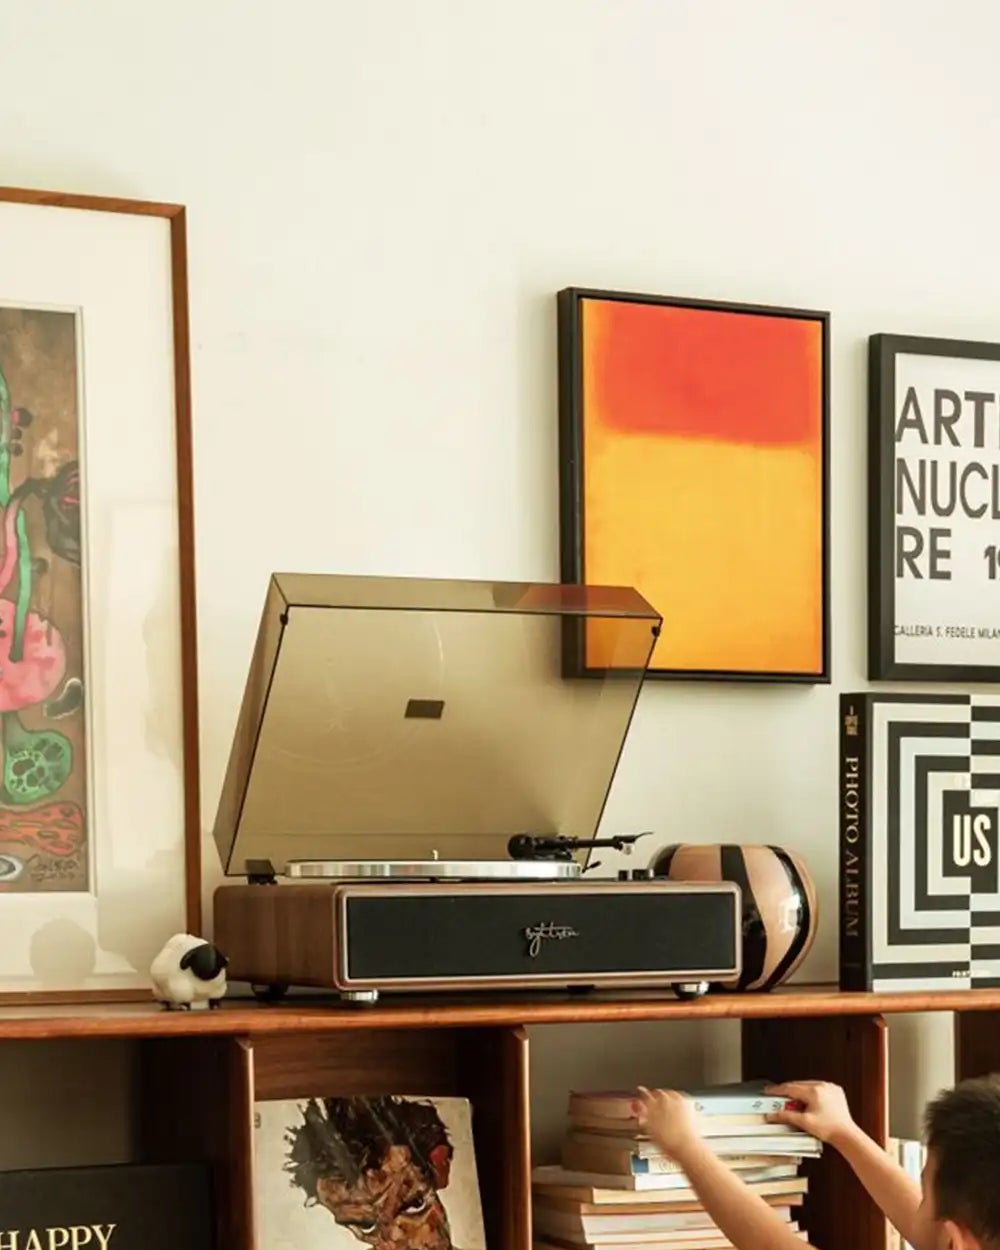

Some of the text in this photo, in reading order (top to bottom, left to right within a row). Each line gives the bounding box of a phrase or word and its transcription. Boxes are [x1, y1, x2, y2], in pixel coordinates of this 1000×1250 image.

[896, 526, 952, 580] RE
[845, 757, 860, 937] PHOTO ALBUM
[952, 814, 992, 867] US
